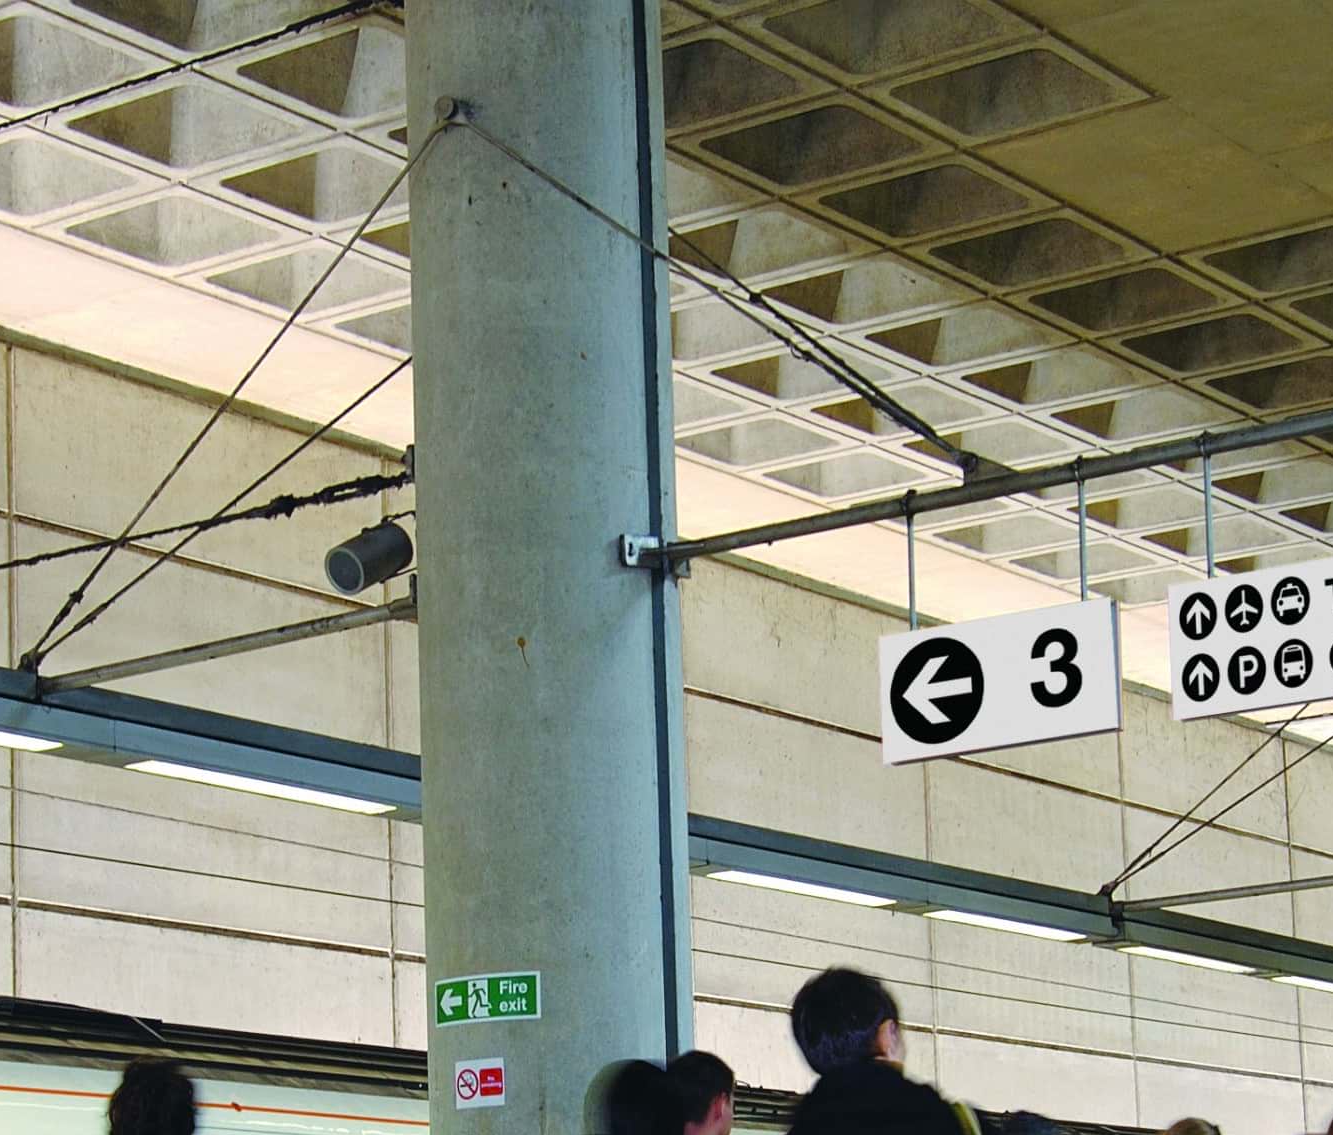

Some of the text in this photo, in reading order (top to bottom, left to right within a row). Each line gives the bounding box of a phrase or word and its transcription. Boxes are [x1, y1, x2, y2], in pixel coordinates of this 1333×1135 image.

[1029, 628, 1083, 709] 3
[499, 980, 528, 995] Fire
[499, 998, 527, 1012] exit
